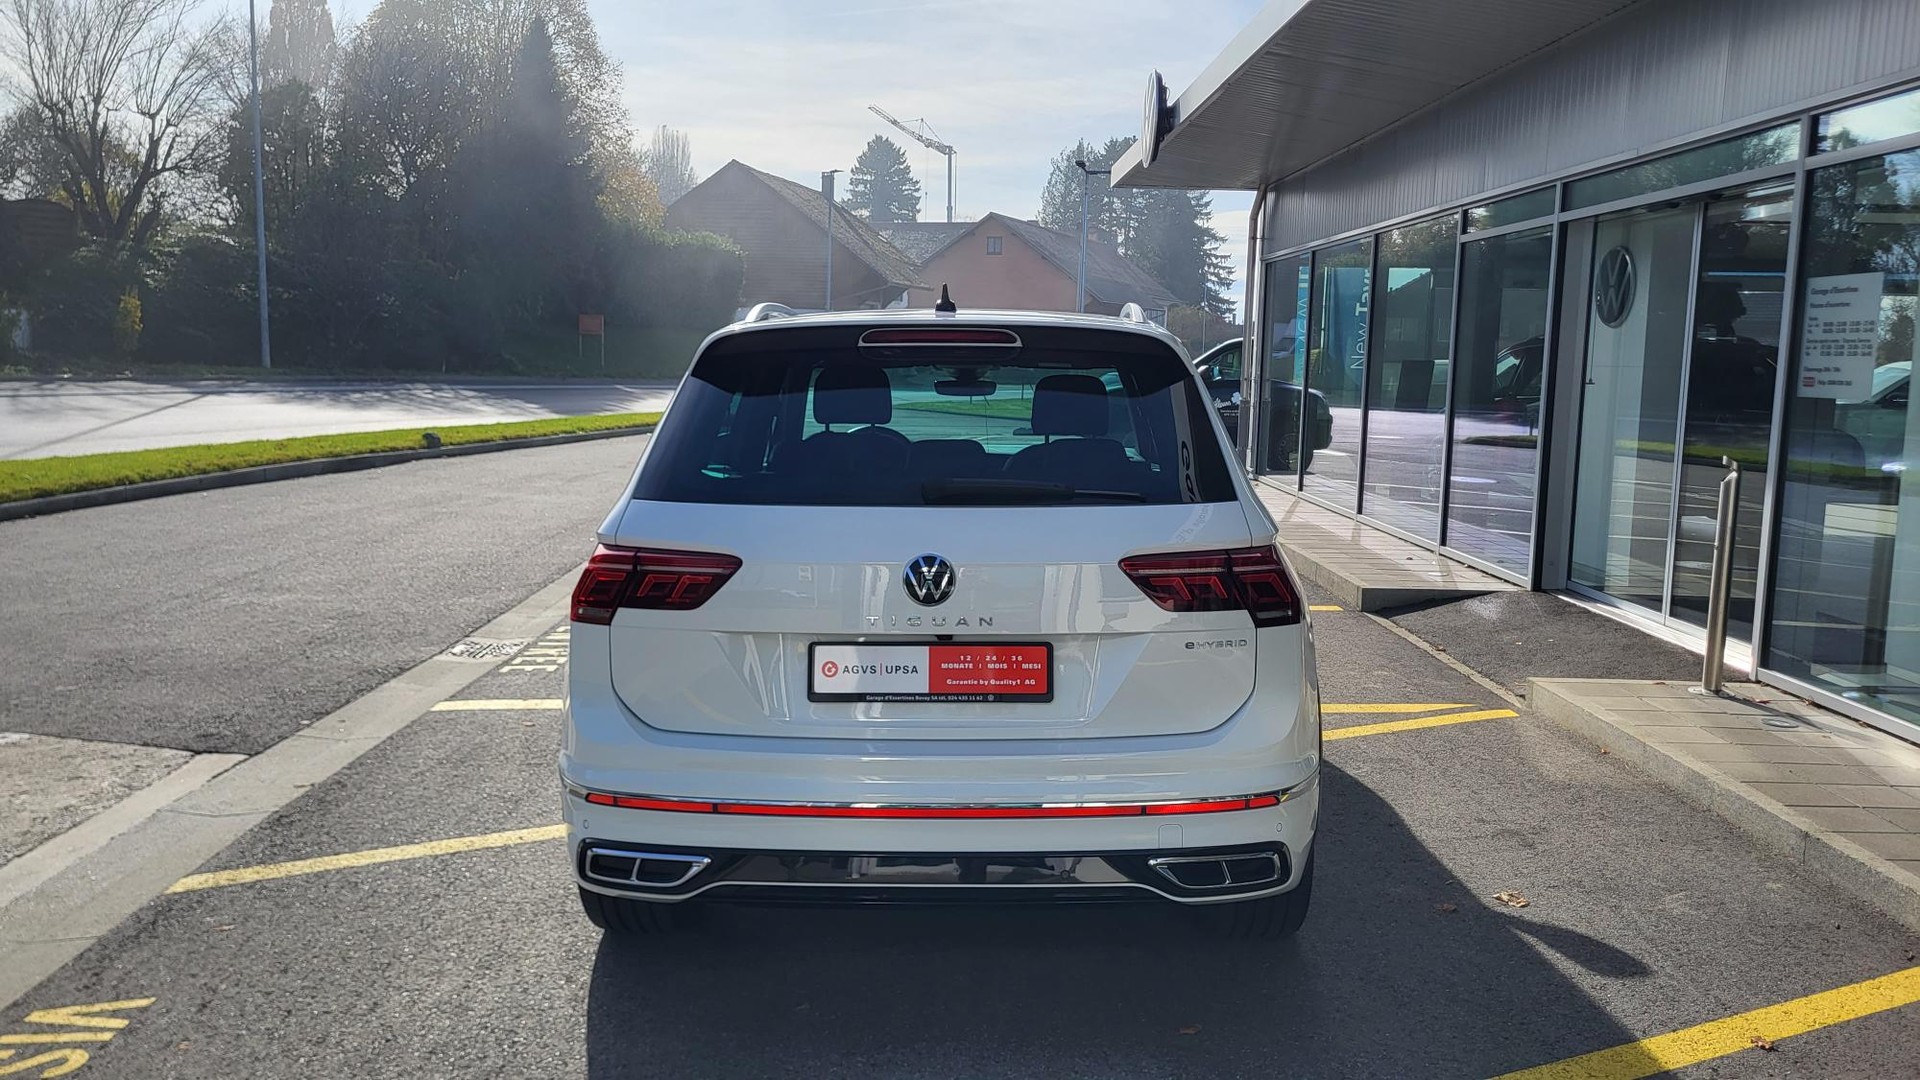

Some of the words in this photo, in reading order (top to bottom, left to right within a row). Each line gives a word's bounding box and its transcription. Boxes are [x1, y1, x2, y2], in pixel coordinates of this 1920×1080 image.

[866, 616, 994, 627] TIGUAN
[842, 665, 877, 674] AGVS
[885, 665, 919, 674] UPSA
